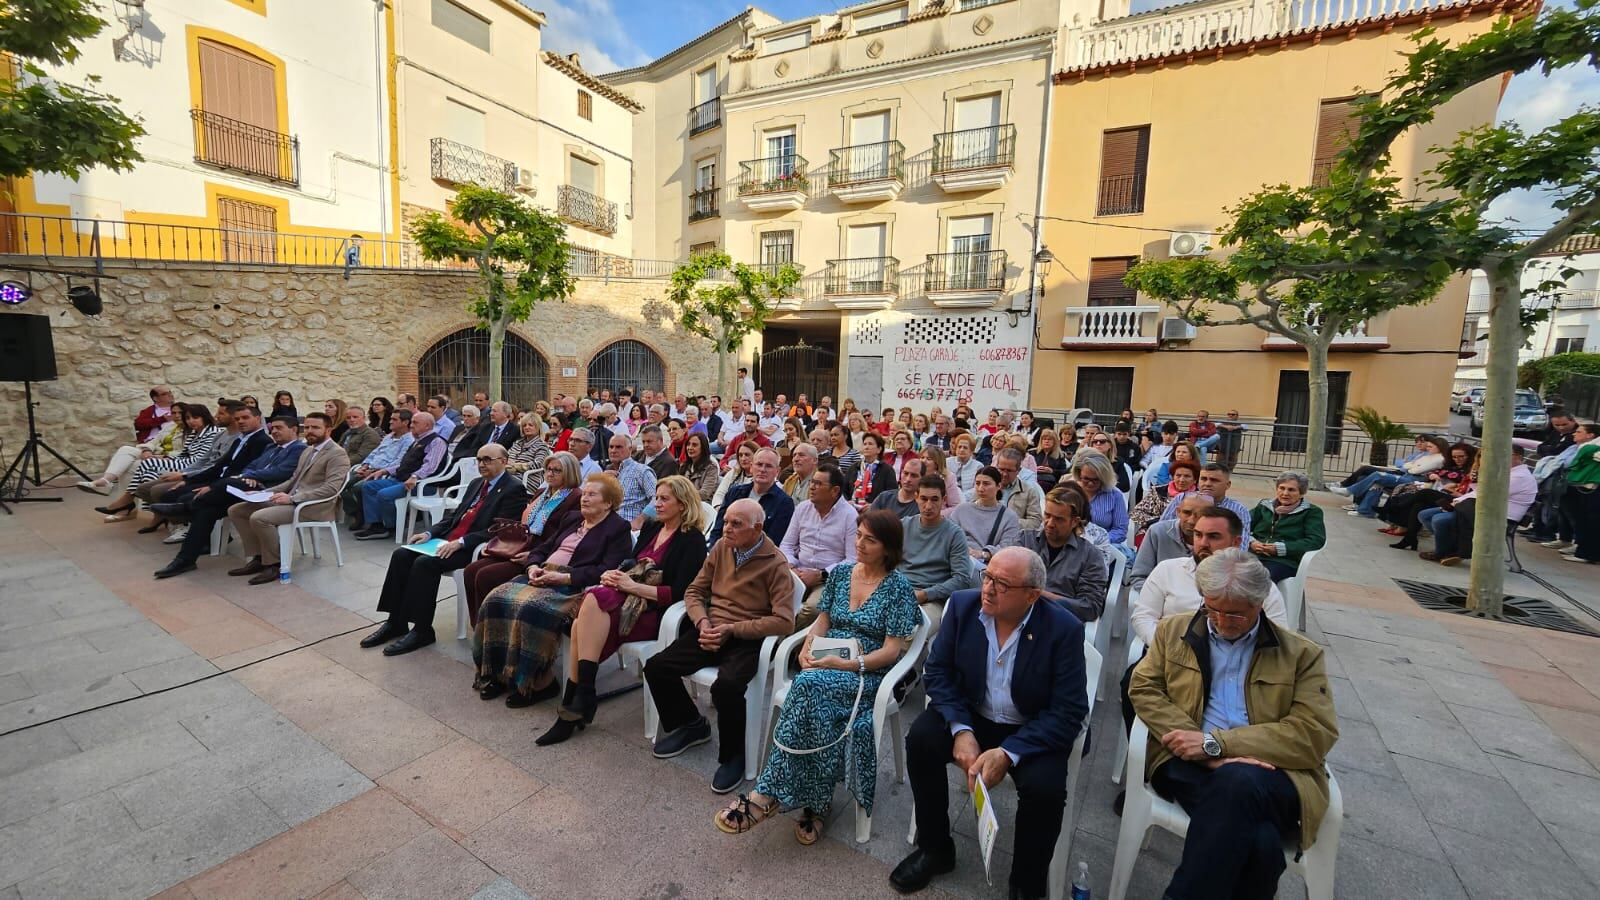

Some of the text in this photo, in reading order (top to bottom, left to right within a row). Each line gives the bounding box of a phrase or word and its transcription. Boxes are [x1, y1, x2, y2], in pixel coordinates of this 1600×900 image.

[895, 347, 1028, 361] PLAZA GARAJE 606878367
[904, 373, 1021, 391] SE VENDE LOCAL
